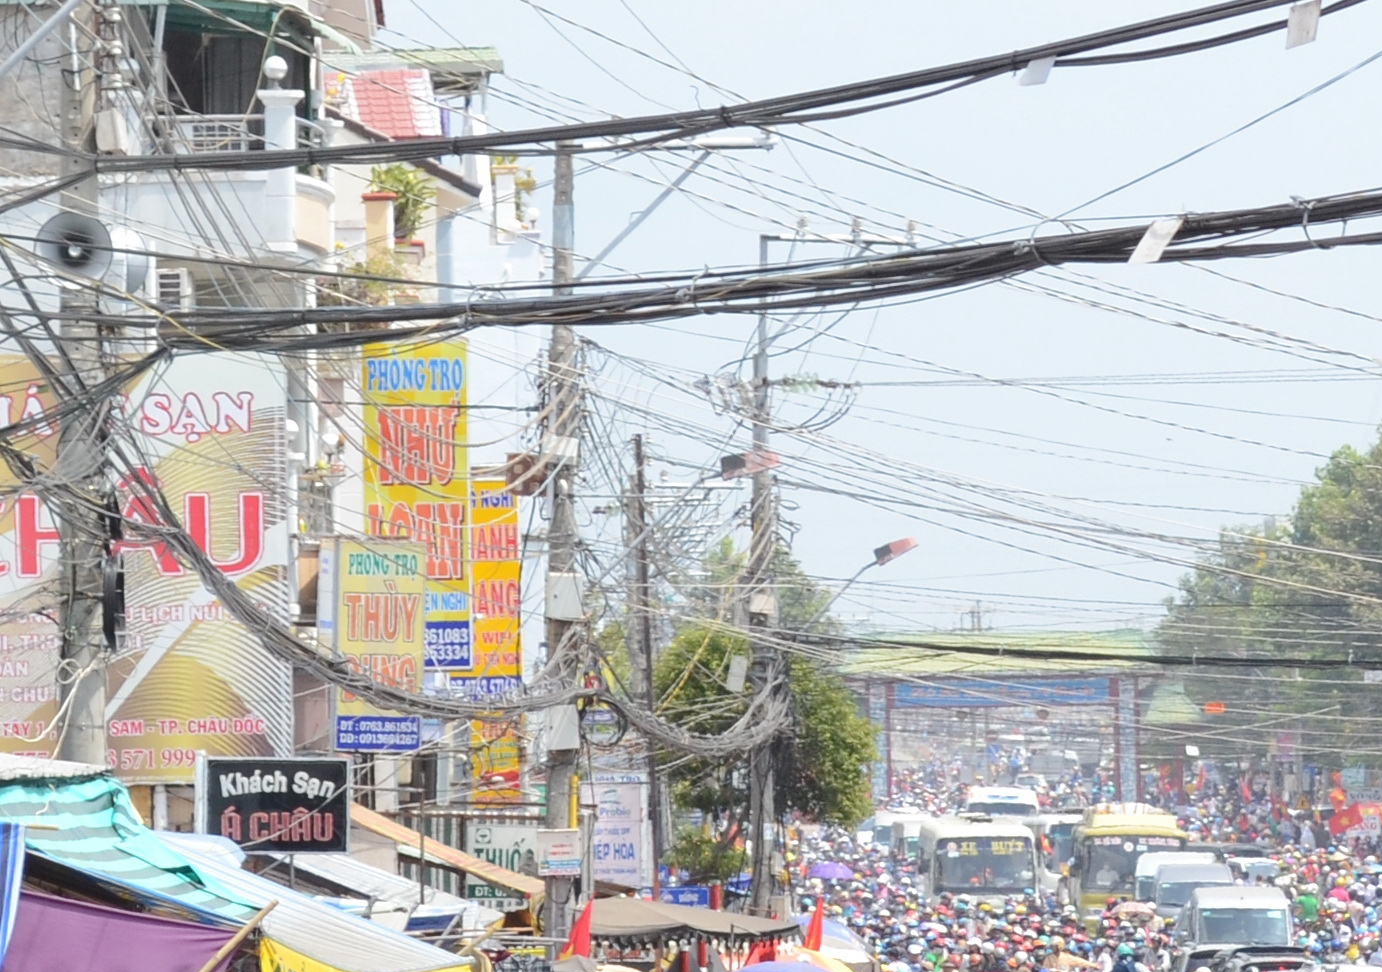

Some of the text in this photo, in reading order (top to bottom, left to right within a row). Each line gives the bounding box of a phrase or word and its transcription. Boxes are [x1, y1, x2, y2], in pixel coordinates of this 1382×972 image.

[0, 465, 267, 578] HÂU
[219, 769, 336, 799] Khách Sạn
[249, 806, 334, 842] CHÂU
